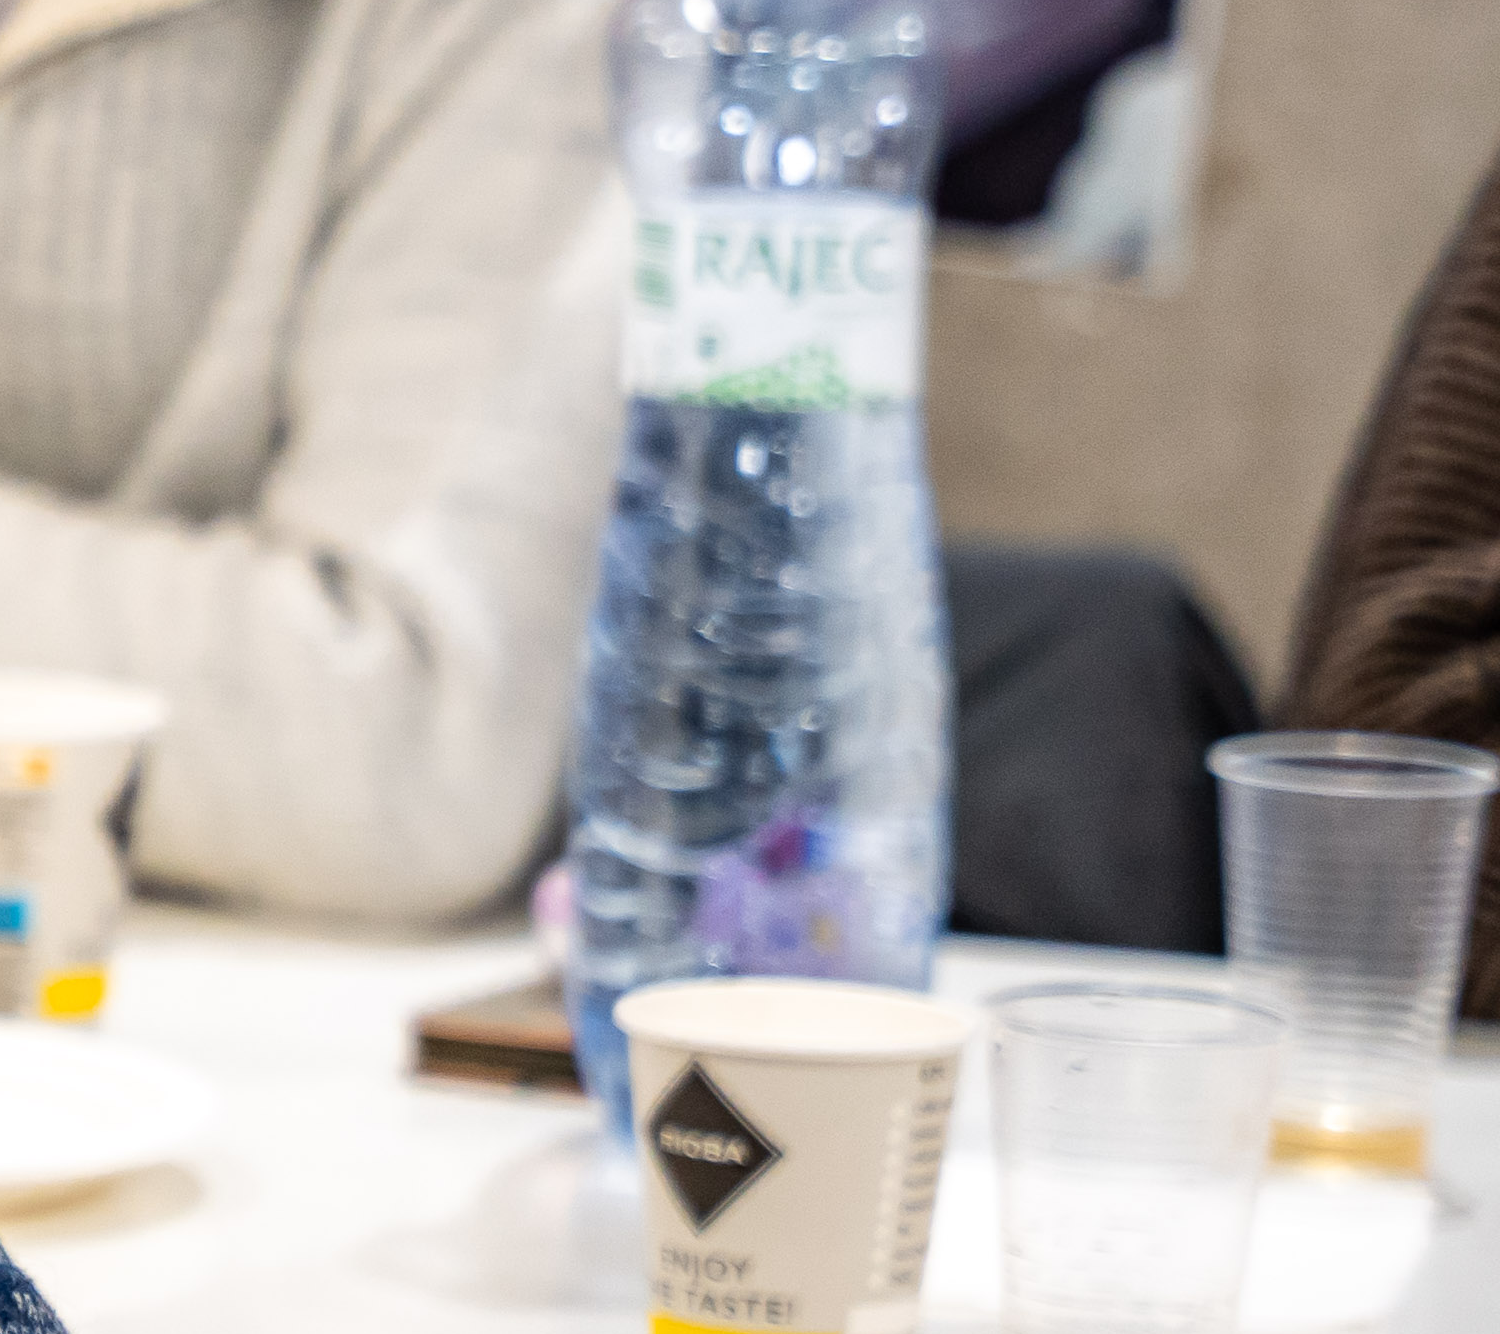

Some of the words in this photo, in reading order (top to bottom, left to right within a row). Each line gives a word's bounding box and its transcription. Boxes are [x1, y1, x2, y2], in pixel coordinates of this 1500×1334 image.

[694, 233, 896, 303] RAJEC
[661, 1243, 750, 1291] ENJOY
[684, 1288, 796, 1326] TASTE!
